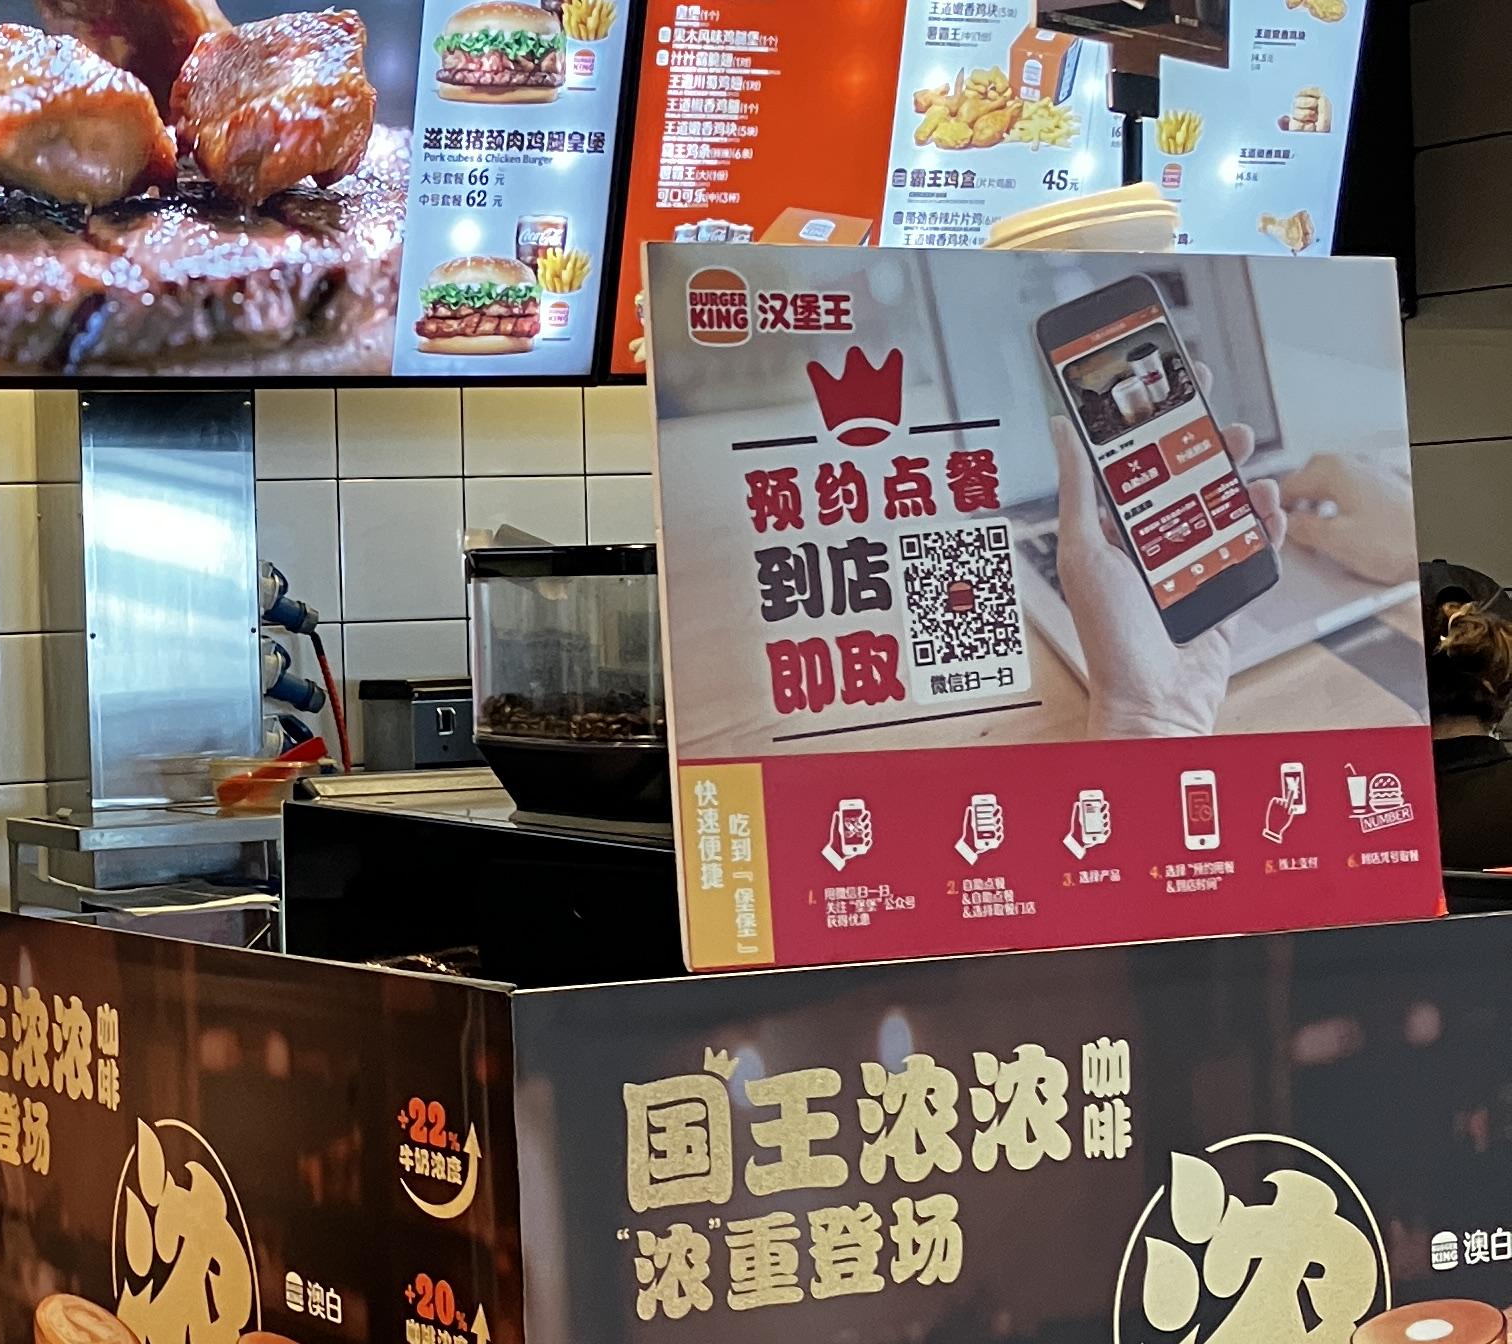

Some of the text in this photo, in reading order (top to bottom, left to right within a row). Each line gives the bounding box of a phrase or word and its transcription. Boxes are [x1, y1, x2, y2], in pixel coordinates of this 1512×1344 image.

[423, 128, 605, 153] 滋滋猪颈肉鸡腿皇堡
[424, 152, 445, 163] Pork
[485, 154, 521, 164] Chicken
[522, 155, 553, 166] Burger
[468, 168, 489, 185] 66
[494, 174, 505, 186] 元
[910, 169, 976, 189] 霸王鸡盒
[1042, 169, 1079, 191] 45元
[466, 190, 487, 207] 62
[492, 195, 503, 207] 元
[689, 291, 747, 307] BURGER
[690, 293, 853, 331] KING 汉堡王
[745, 449, 1000, 533] 预约点餐
[754, 536, 892, 622] 到店
[766, 630, 906, 714] 即取
[930, 667, 1014, 695] 微信扫一扫
[694, 780, 725, 890] 快速便捷
[1363, 807, 1412, 830] NUMBER
[96, 1002, 120, 1112] 咖啡
[397, 1097, 461, 1152] +22%
[623, 1037, 1132, 1213] 国王浓浓 咖啡
[399, 1144, 463, 1186] 牛奶浓度
[1463, 1227, 1512, 1265] 澳白
[306, 1280, 342, 1324] 澳白
[405, 1273, 468, 1333] +20%
